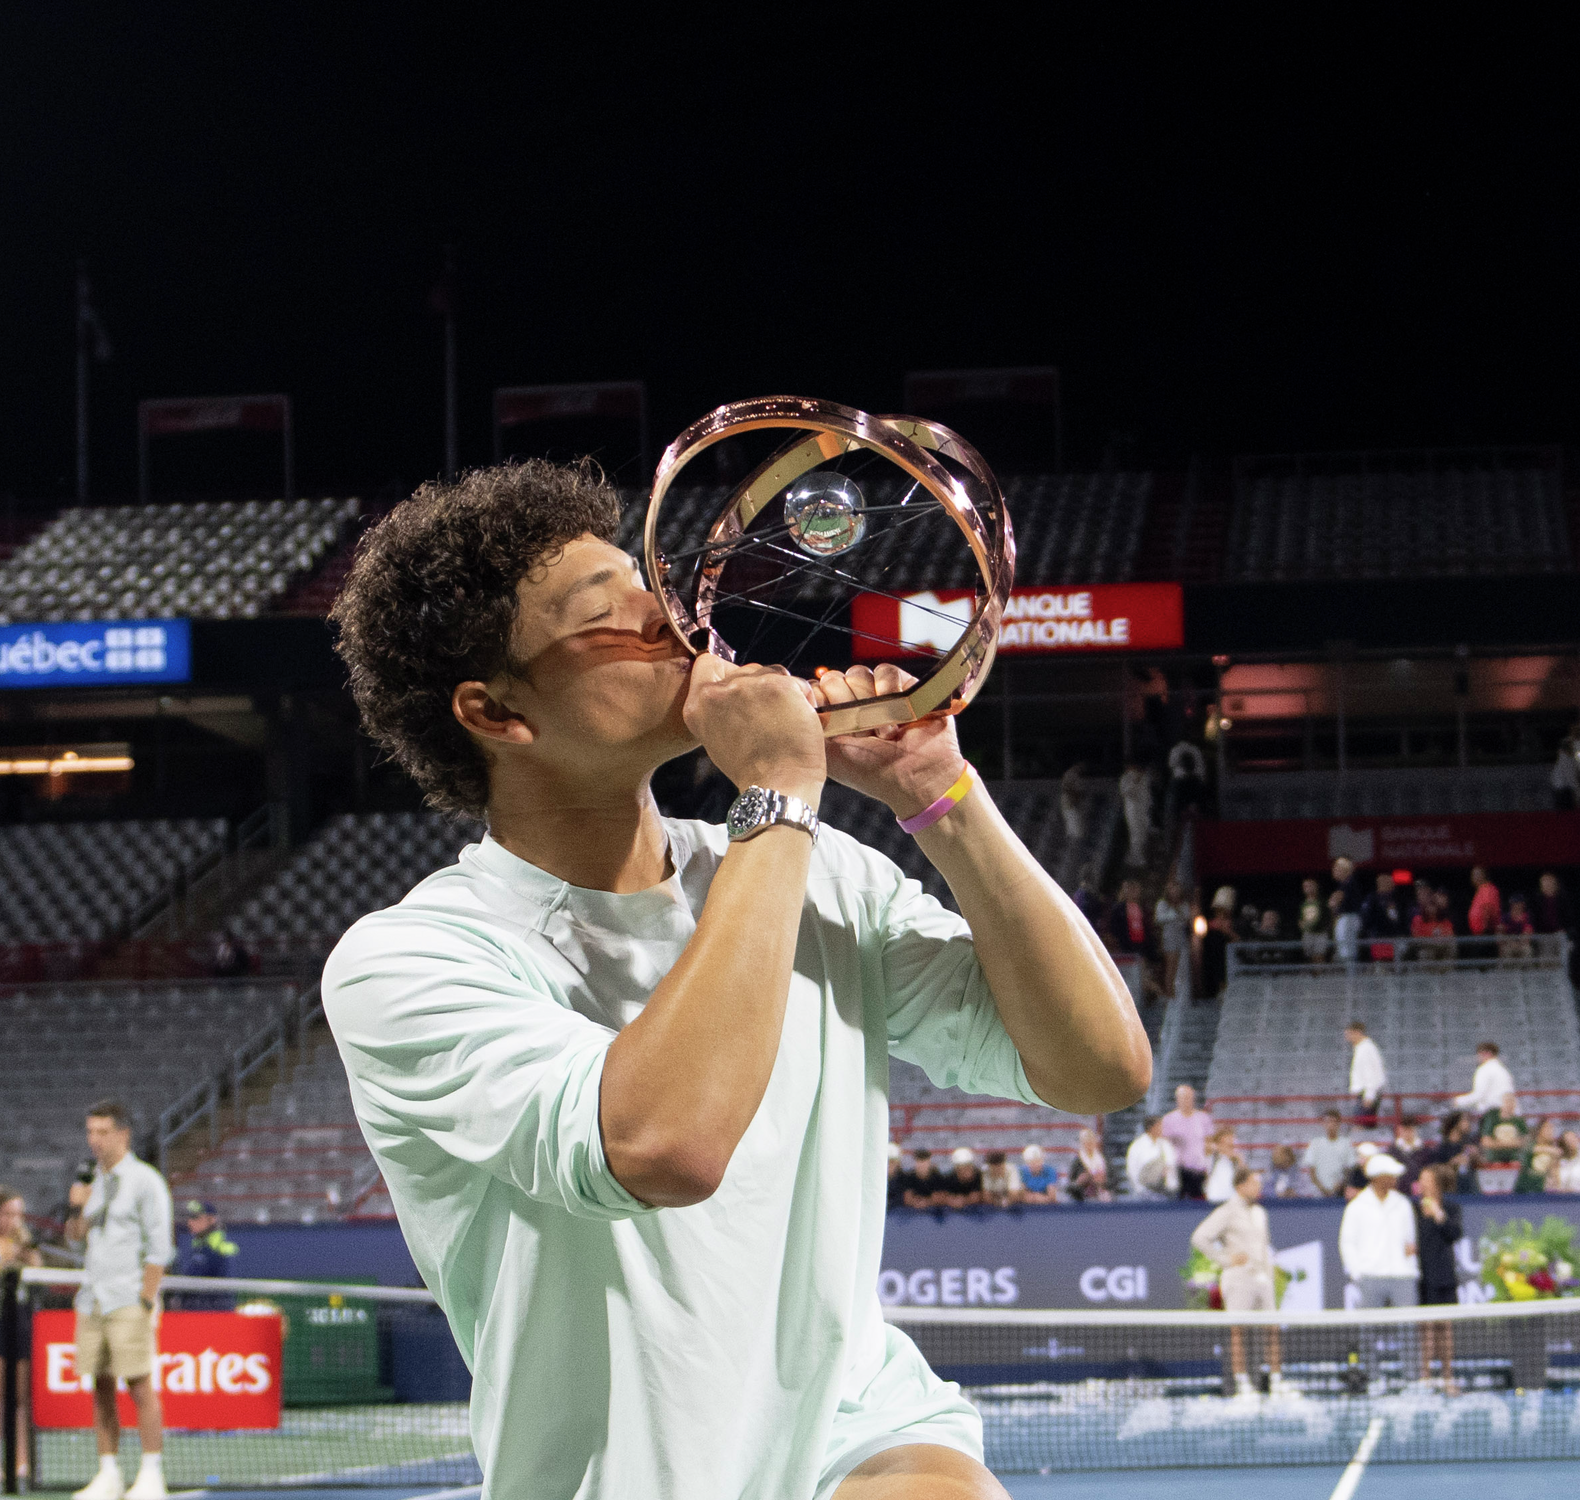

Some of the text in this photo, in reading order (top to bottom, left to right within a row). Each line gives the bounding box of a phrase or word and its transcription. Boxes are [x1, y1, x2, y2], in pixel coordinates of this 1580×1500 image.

[1003, 591, 1093, 617] ANQUE
[997, 617, 1130, 647] ATIONALE
[1078, 1265, 1148, 1302] CGI
